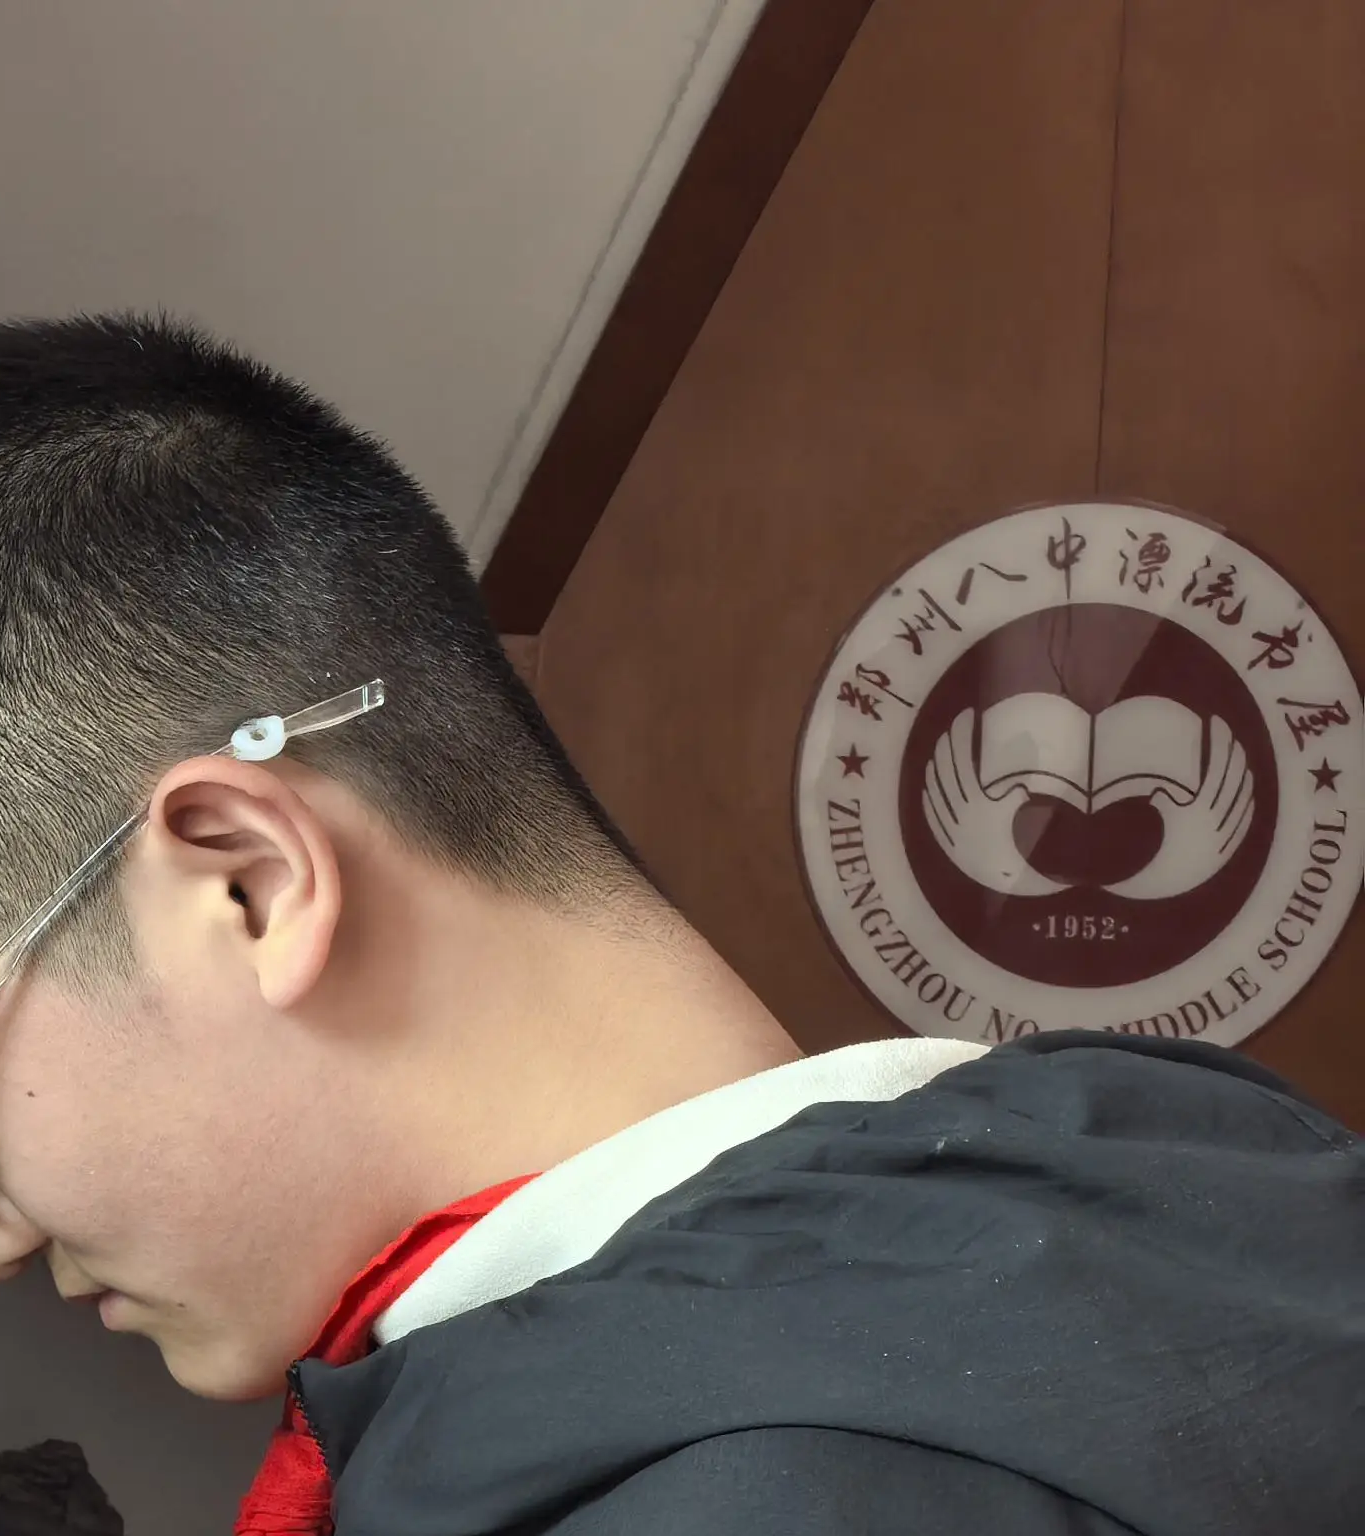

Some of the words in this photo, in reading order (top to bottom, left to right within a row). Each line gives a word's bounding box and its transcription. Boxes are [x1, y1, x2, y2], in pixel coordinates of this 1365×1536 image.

[828, 798, 977, 1023] ZHENGZHOU
[1257, 809, 1348, 973] SCHOOL
[1044, 915, 1117, 940] 1952
